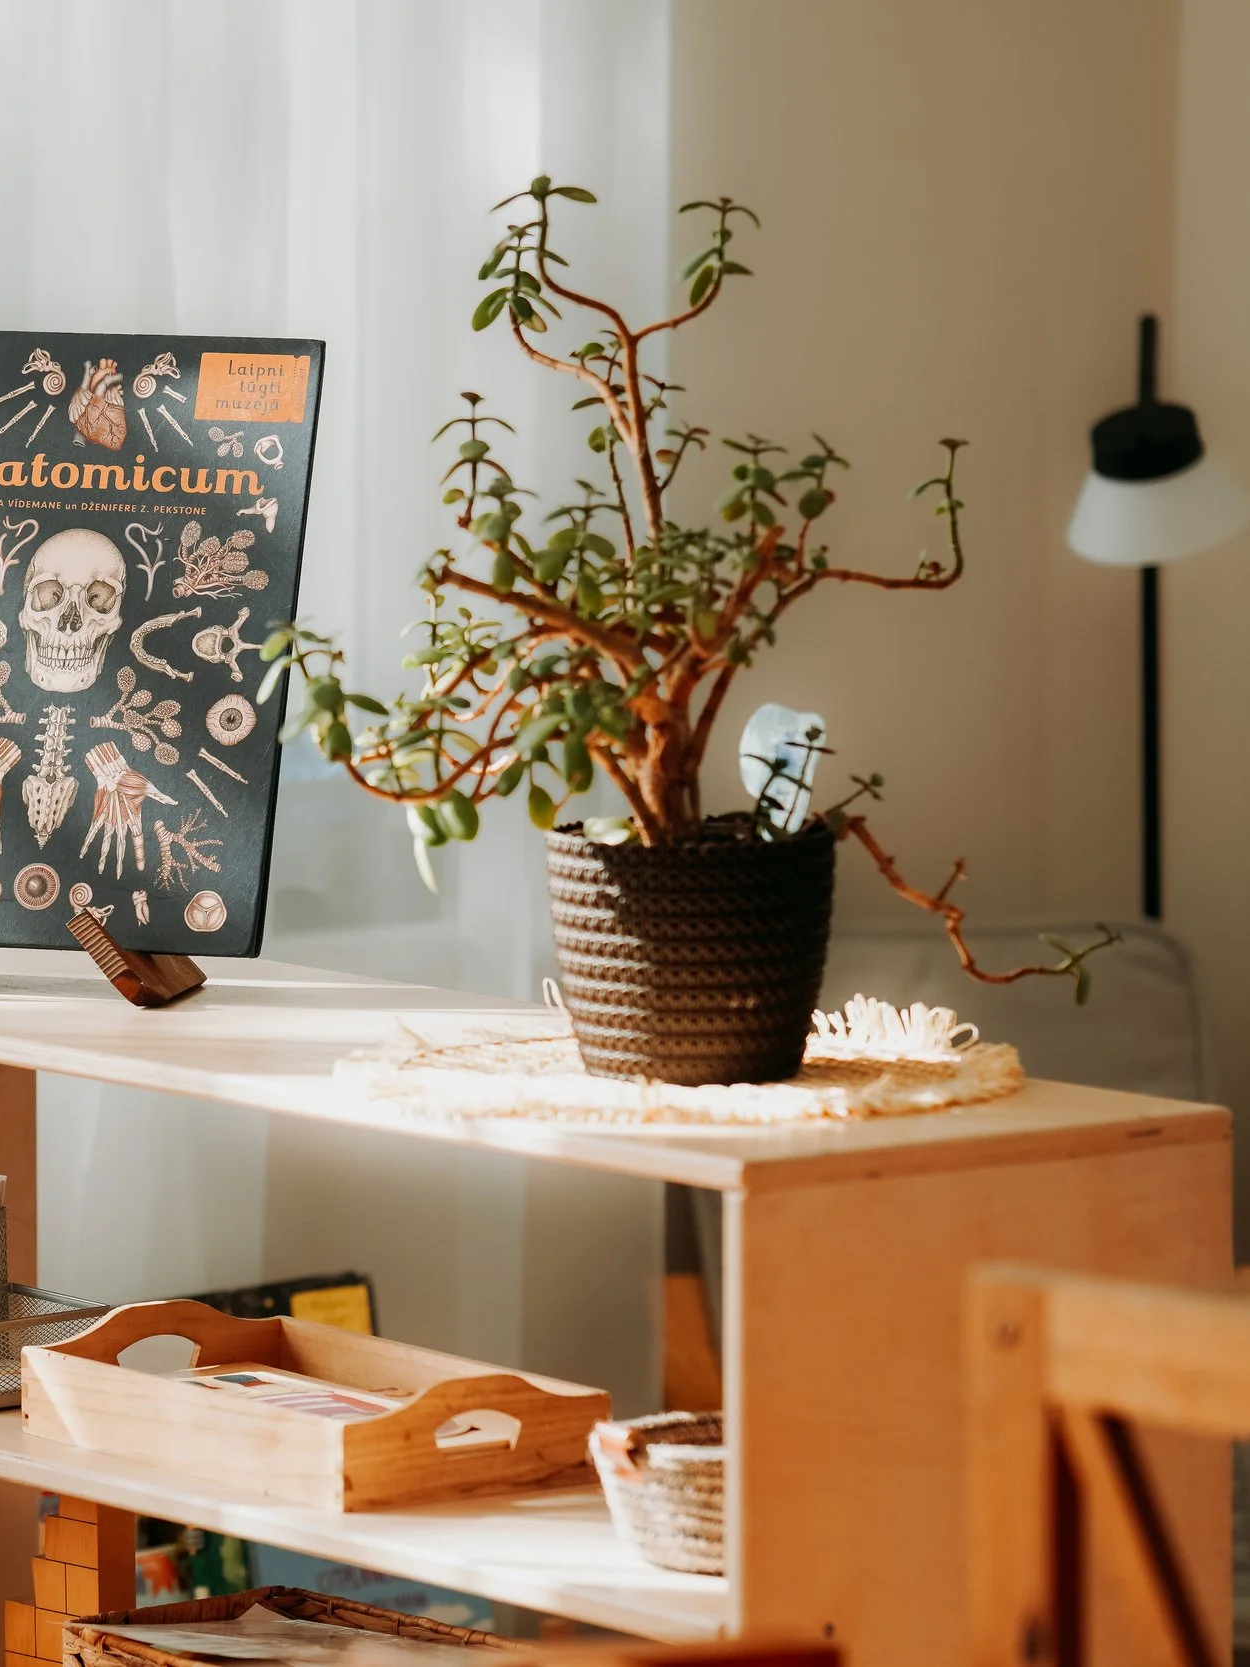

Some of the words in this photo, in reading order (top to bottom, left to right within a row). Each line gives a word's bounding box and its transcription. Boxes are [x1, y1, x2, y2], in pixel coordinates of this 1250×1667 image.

[228, 359, 285, 381] Laipni
[239, 380, 282, 399] lūgti
[215, 399, 279, 416] muzejā
[8, 498, 62, 510] VĪDEMANE
[81, 501, 137, 513] DŽENIFERE
[140, 504, 150, 513] Z.
[153, 505, 207, 515] PEKSTONE
